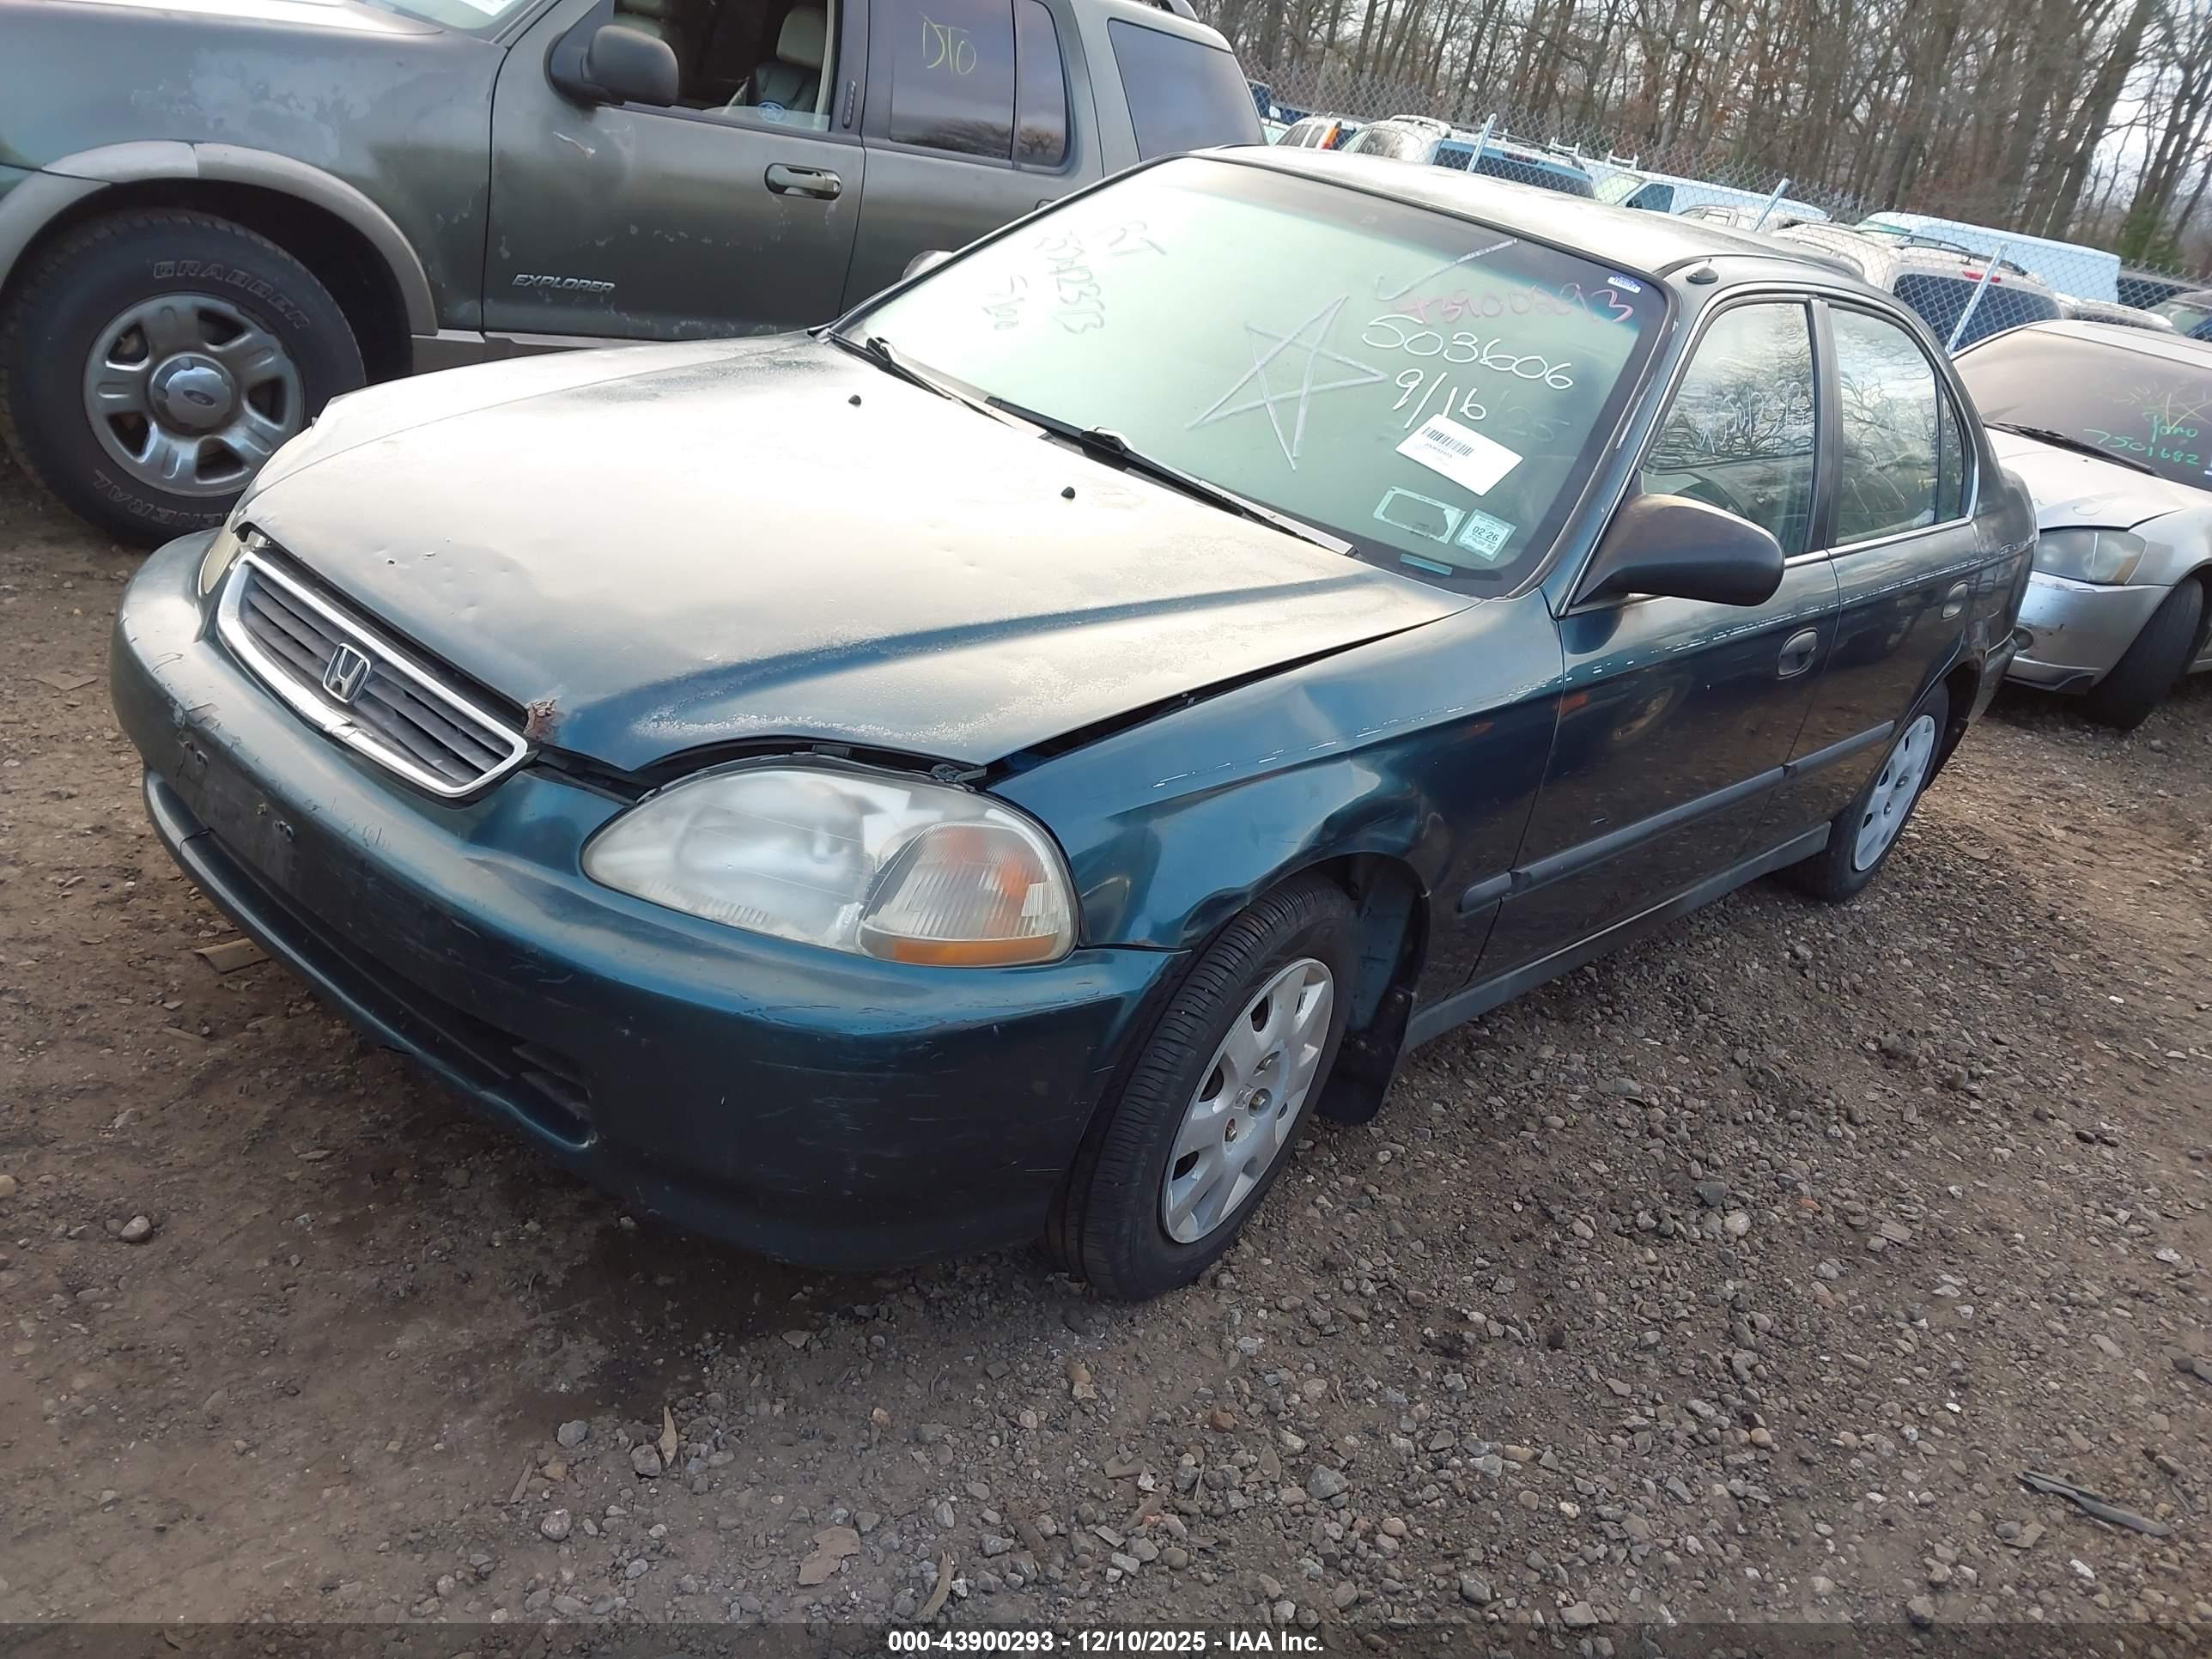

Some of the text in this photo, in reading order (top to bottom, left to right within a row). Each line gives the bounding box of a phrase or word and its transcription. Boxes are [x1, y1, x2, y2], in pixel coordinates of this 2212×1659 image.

[154, 259, 311, 330] GRABBER
[512, 274, 616, 293] EXPLORER
[1361, 313, 1574, 390] 503606
[2082, 428, 2200, 465] 7501682
[92, 469, 230, 529] ENERAL
